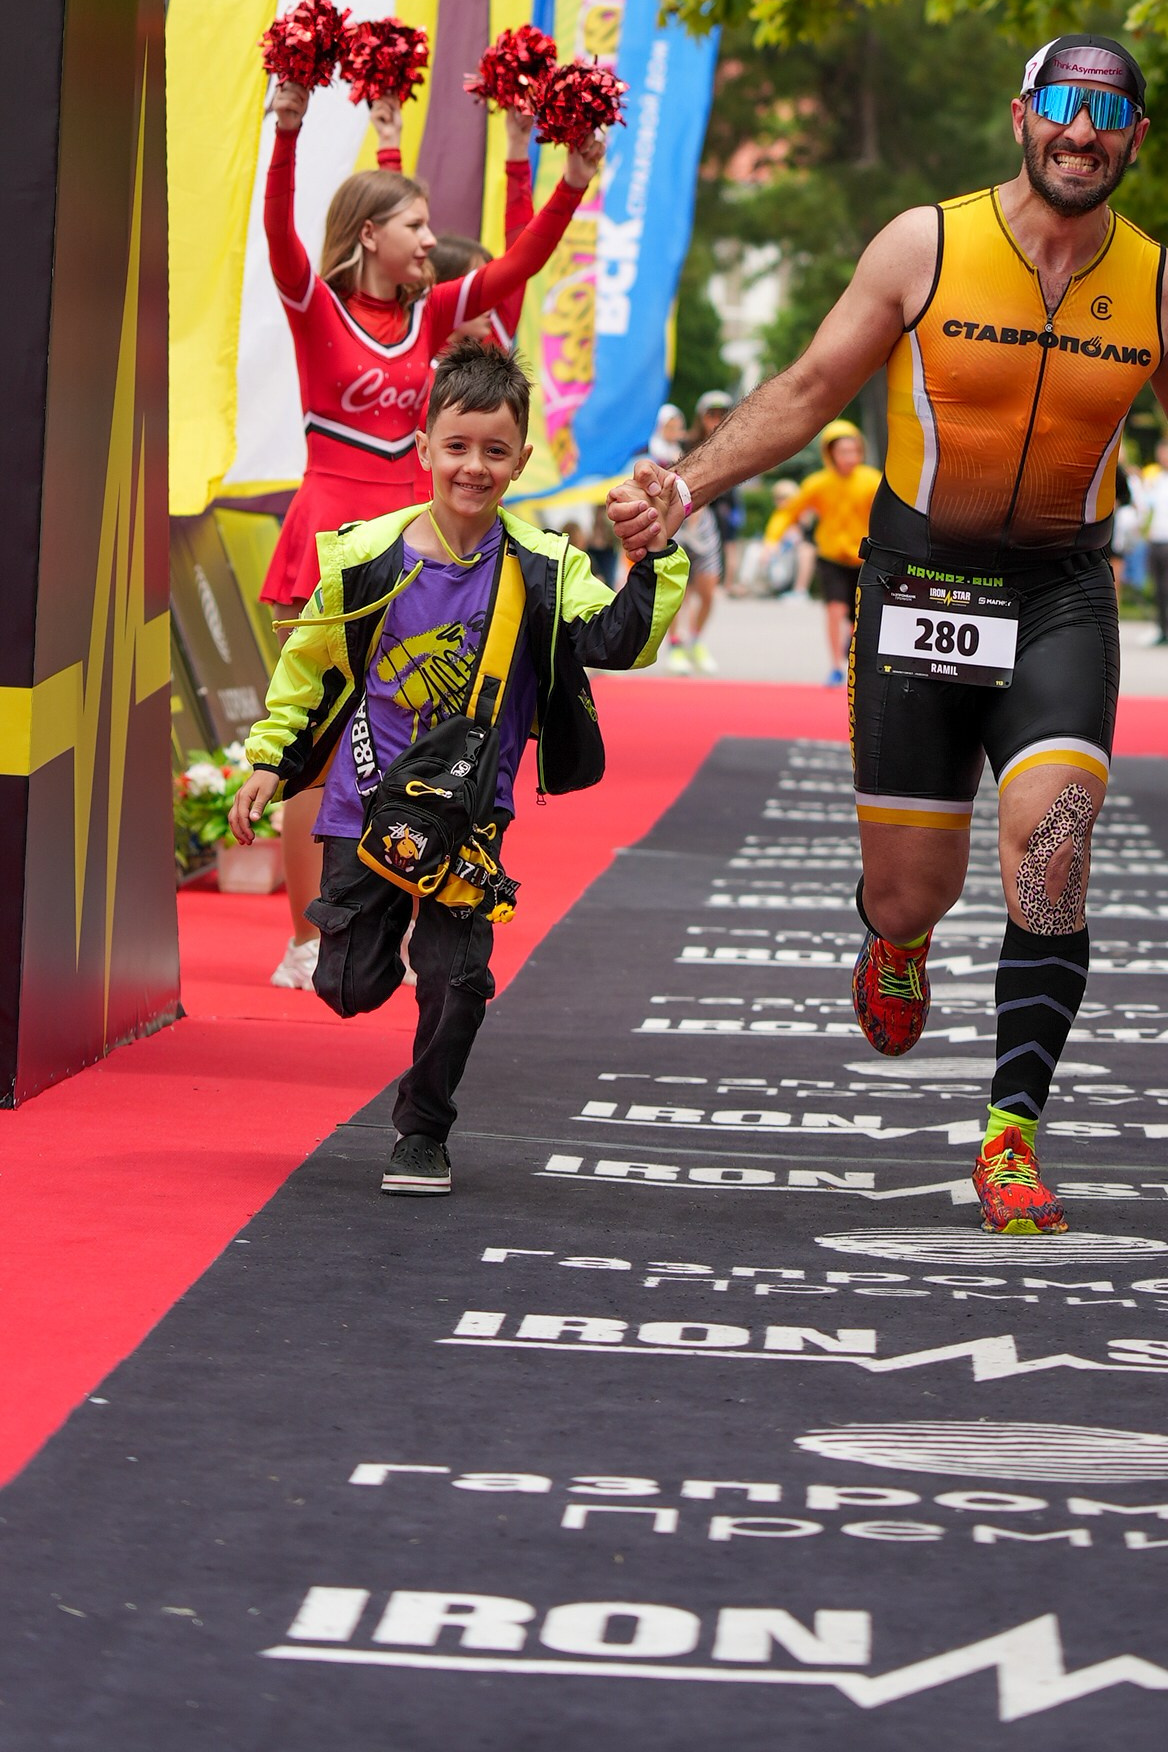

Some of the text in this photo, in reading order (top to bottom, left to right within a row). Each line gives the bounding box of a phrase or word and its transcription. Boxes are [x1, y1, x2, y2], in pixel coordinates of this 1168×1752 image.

[942, 319, 1152, 367] СТАВРОПОЛИС
[929, 587, 972, 601] IRON STAR
[913, 617, 980, 658] 280
[930, 663, 959, 676] RAMIL
[579, 1101, 882, 1129] IRON
[544, 1154, 875, 1189] IRON
[453, 1310, 877, 1354] IRON
[286, 1585, 873, 1667] IRON
